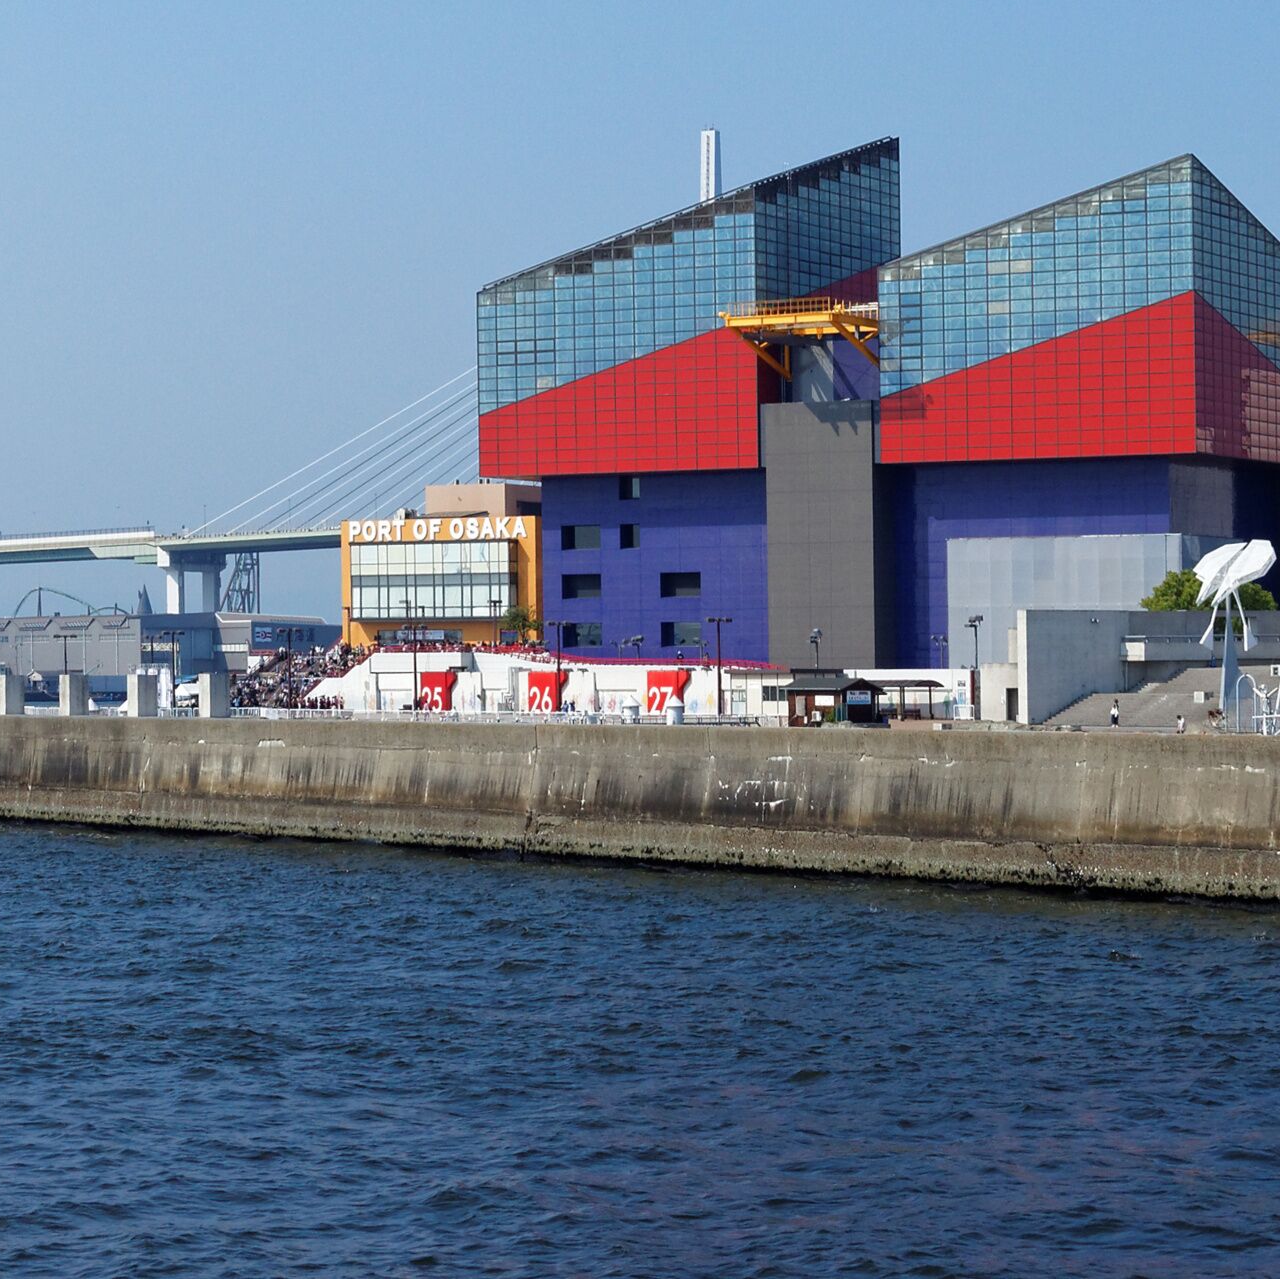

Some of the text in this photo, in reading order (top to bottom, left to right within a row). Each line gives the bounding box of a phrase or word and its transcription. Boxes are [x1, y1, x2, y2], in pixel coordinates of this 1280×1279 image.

[348, 516, 527, 542] PORT OF OSAKA
[421, 686, 443, 712] 25
[529, 686, 553, 714] 26
[648, 686, 674, 715] 27
